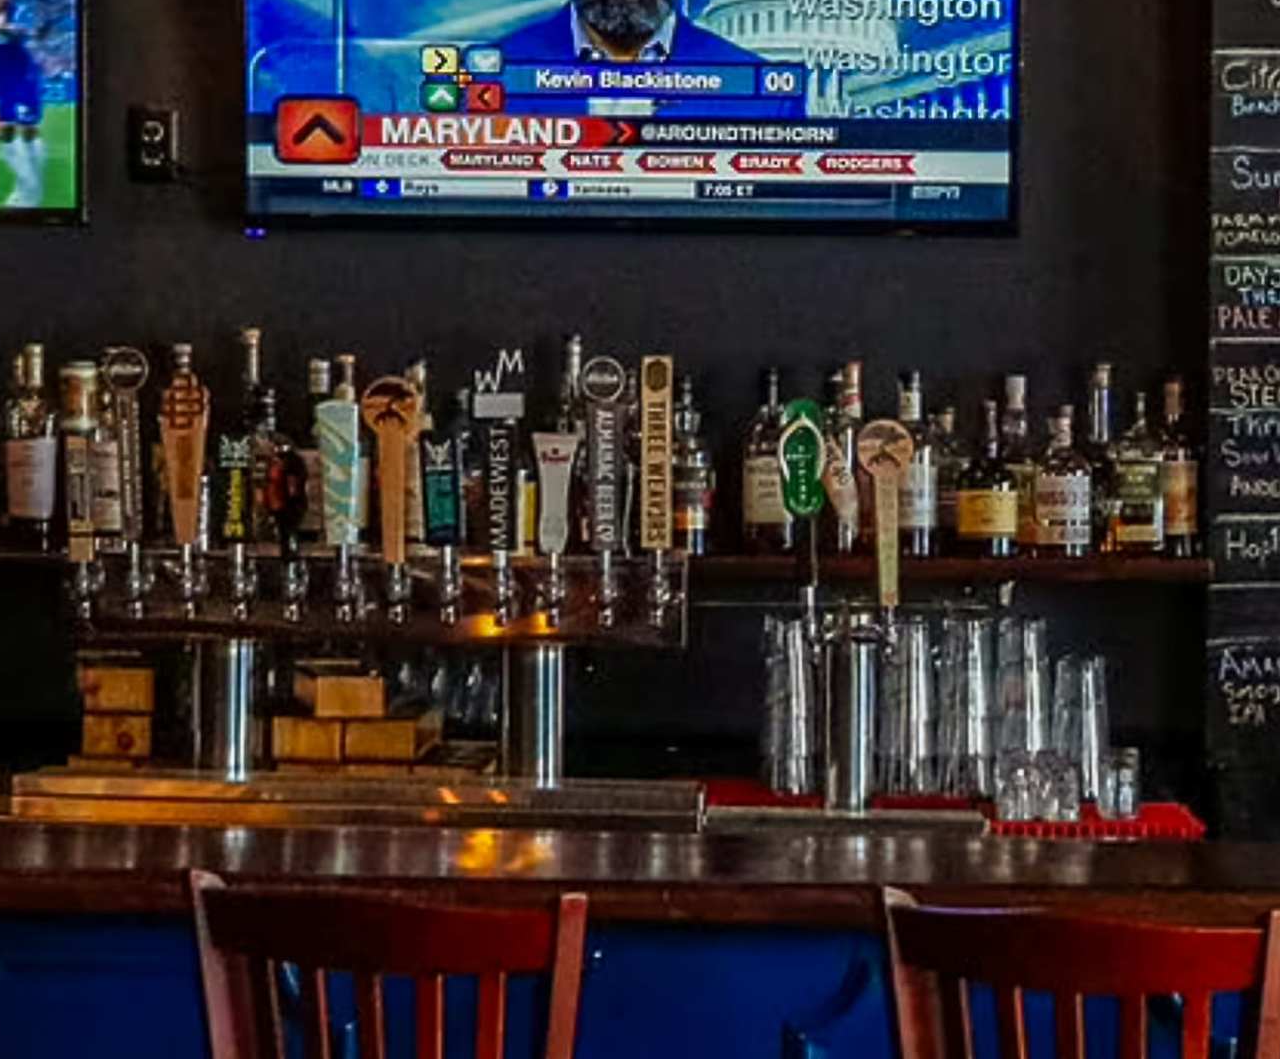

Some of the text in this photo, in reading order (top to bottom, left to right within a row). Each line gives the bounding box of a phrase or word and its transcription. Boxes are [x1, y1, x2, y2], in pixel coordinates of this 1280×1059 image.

[535, 70, 722, 90] Kevin Blackistone
[764, 71, 795, 91] 00
[381, 117, 580, 145] MARYLAND
[385, 153, 430, 168] DECK
[449, 153, 534, 168] MARYLAND
[570, 153, 612, 168] NATS
[646, 154, 705, 170] BOWEN
[825, 156, 904, 172] RODGERS
[647, 401, 667, 452] THREE
